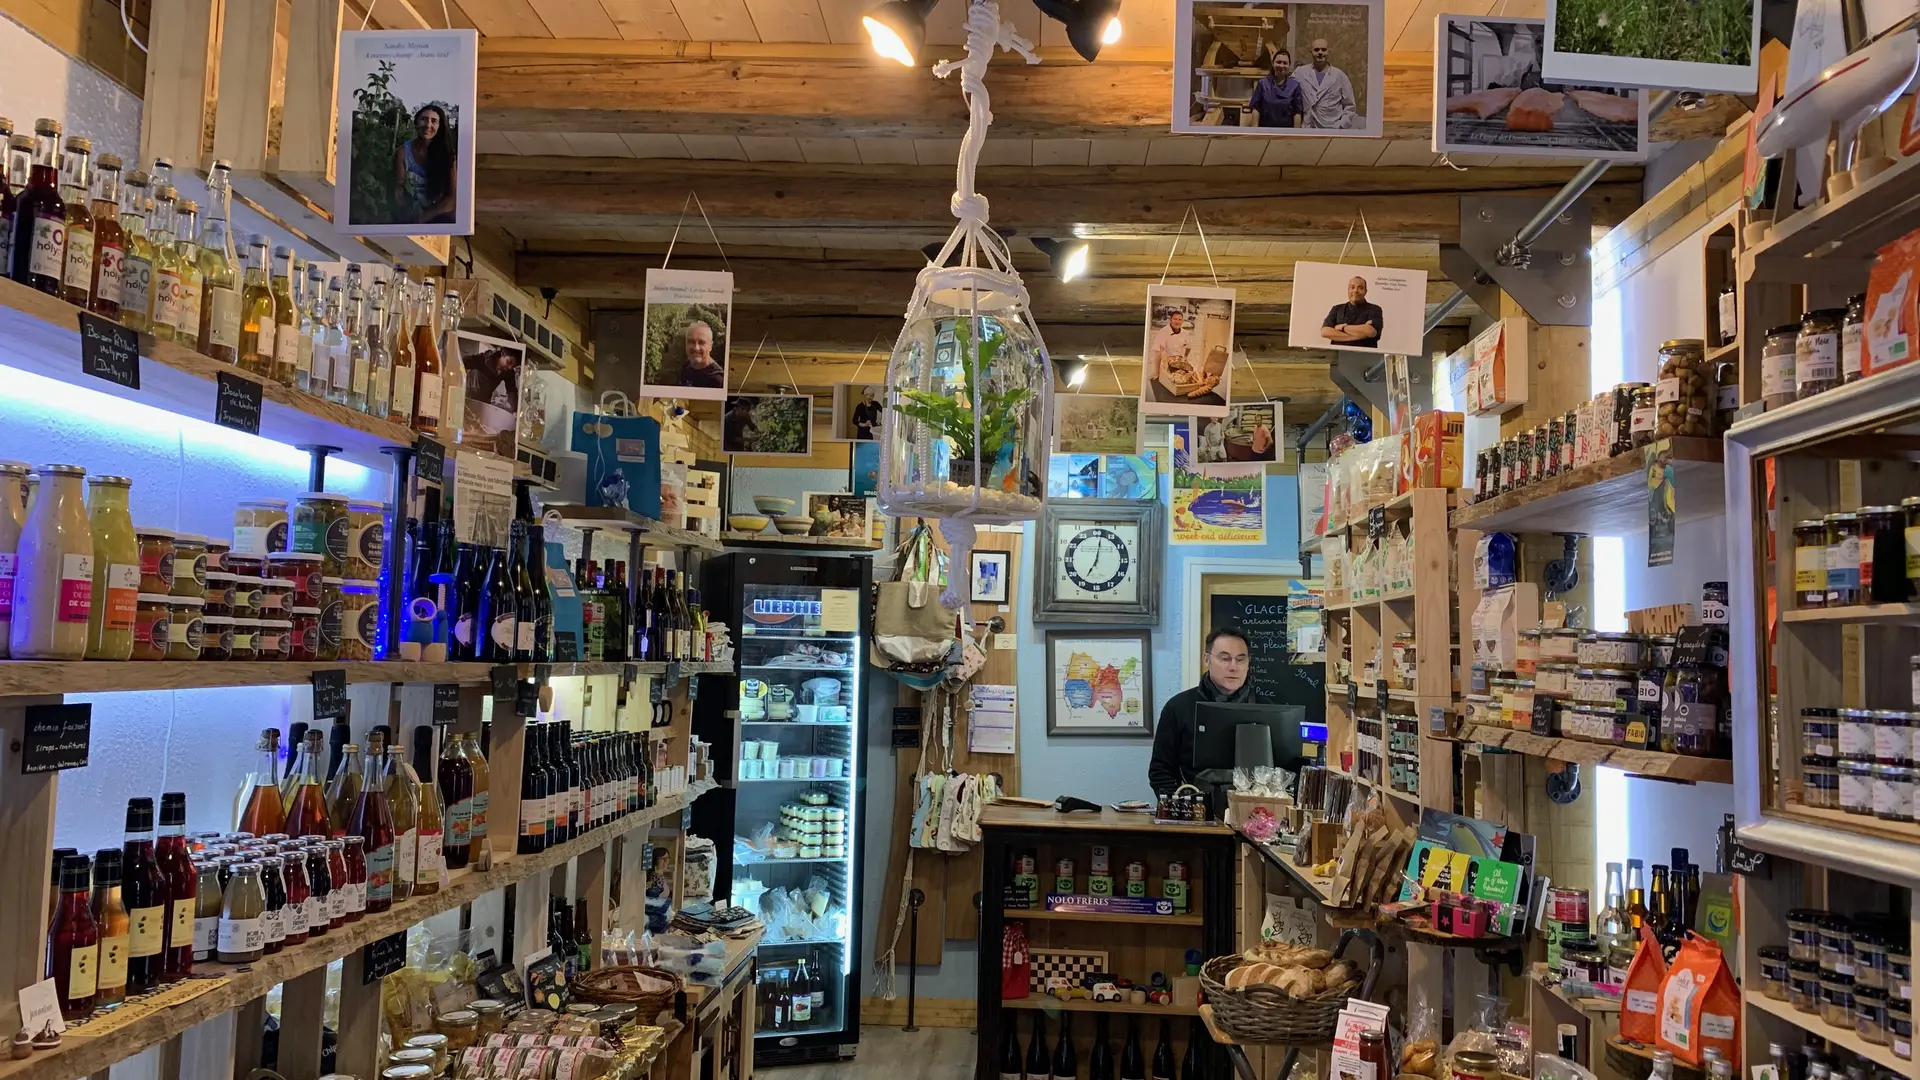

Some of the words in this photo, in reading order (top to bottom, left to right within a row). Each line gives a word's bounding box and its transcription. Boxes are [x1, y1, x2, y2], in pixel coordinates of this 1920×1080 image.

[1176, 531, 1216, 540] week-end
[1218, 531, 1259, 540] délicieux
[1048, 896, 1075, 904] NOLO
[1077, 897, 1109, 906] FRÈRES
